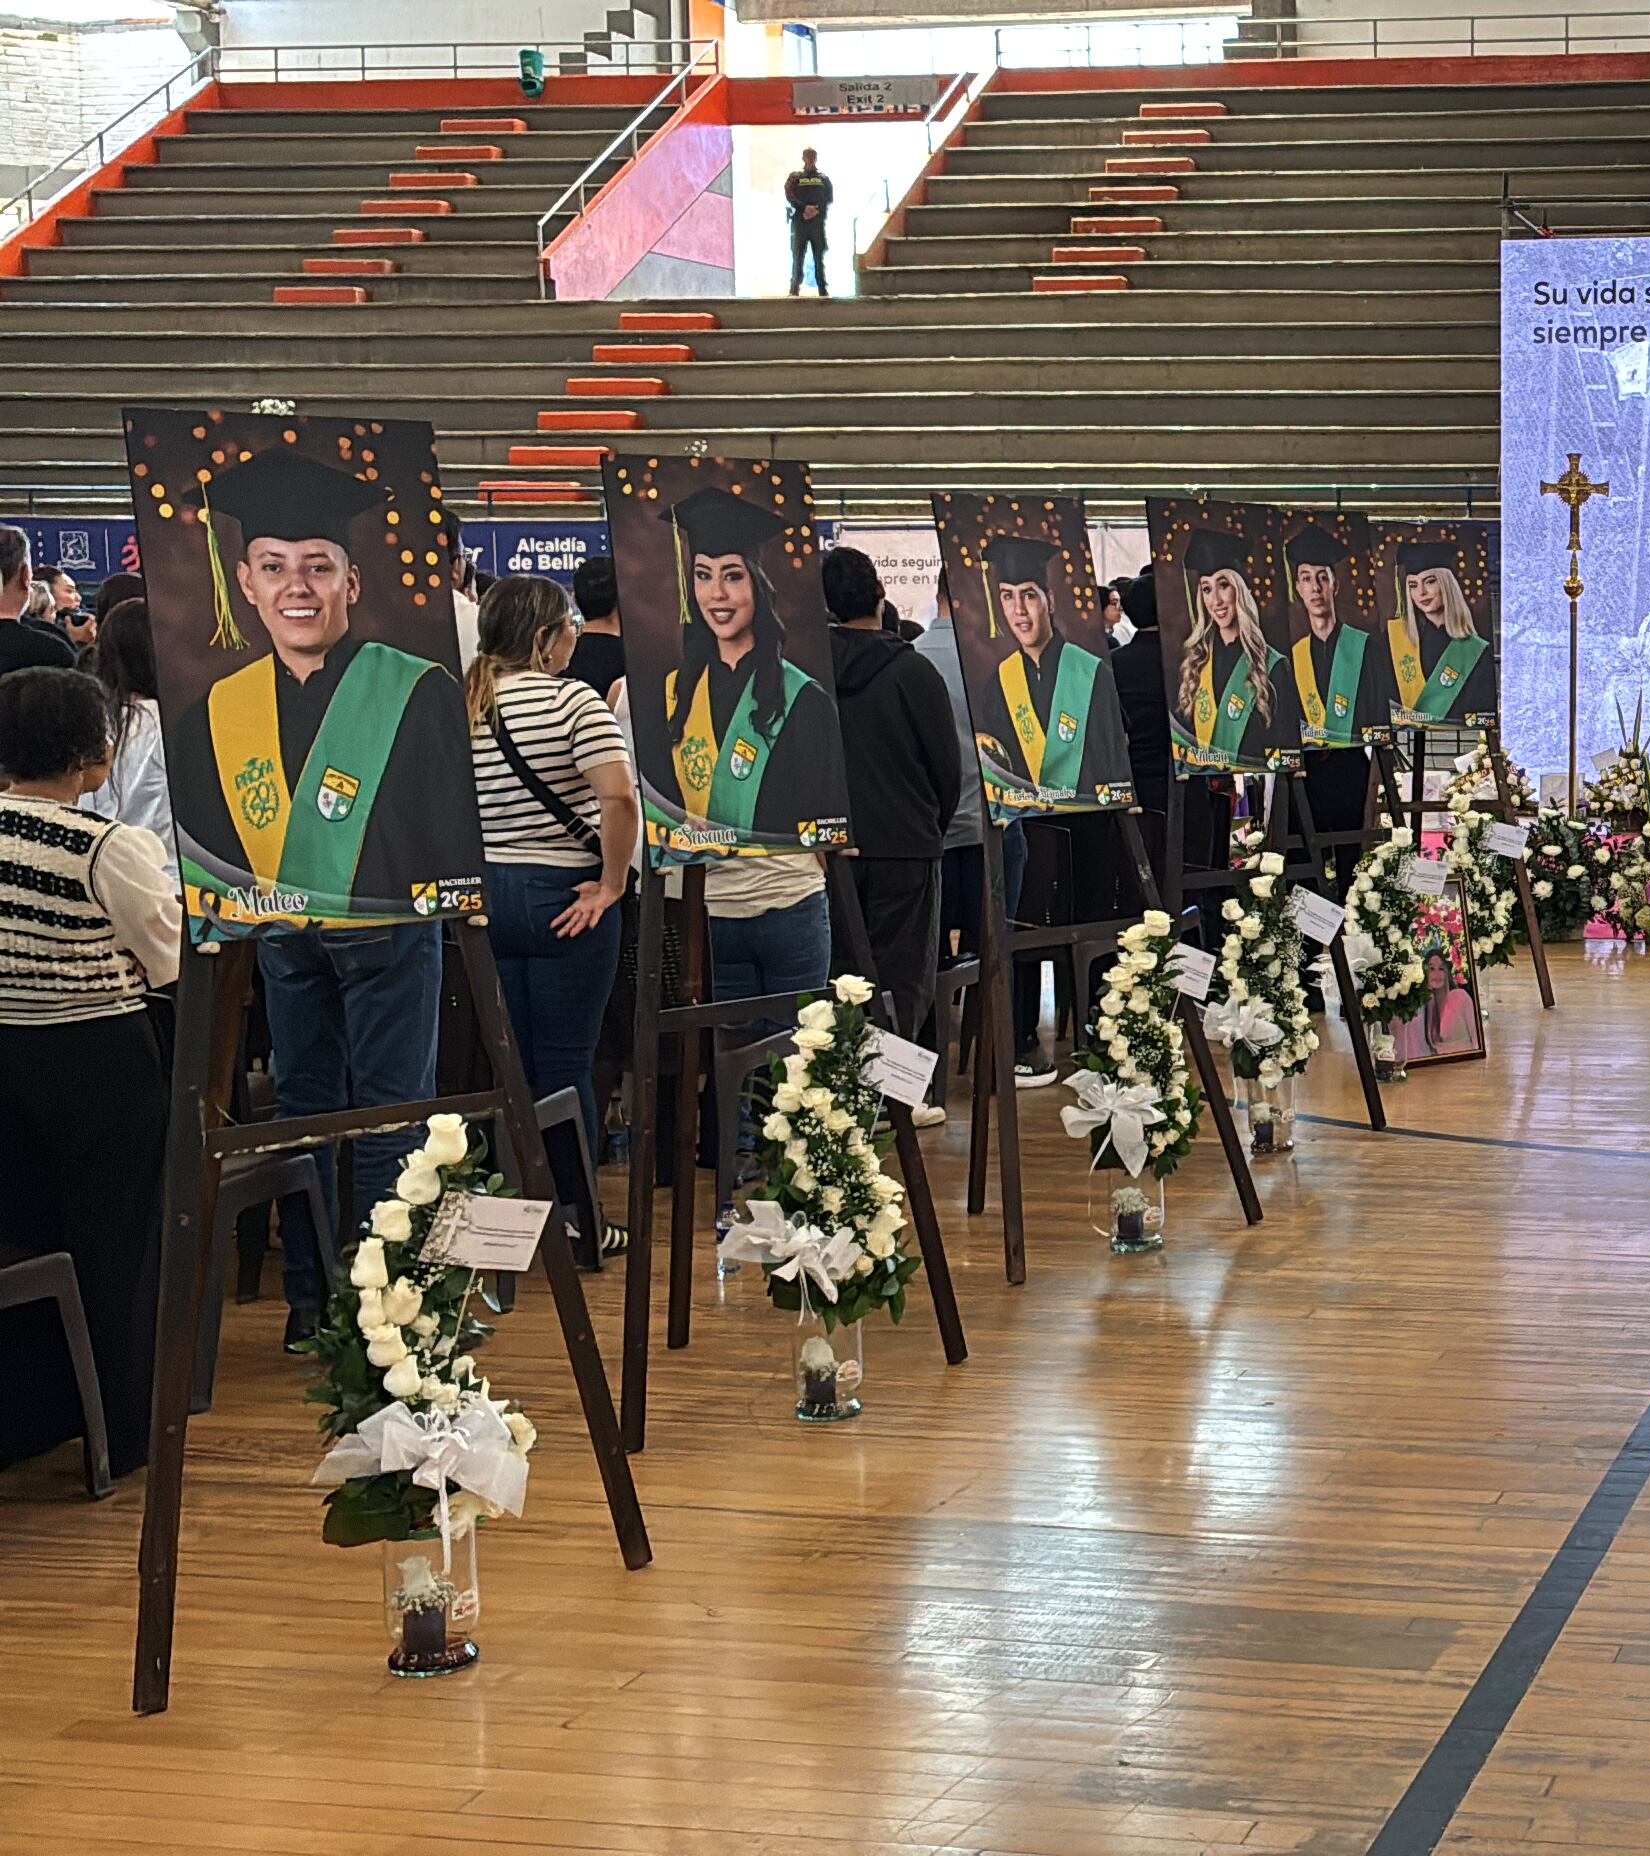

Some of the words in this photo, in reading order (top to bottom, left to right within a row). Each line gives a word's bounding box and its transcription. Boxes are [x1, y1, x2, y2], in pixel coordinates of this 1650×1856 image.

[839, 82, 880, 92] Salida
[884, 82, 893, 91] 2
[847, 95, 873, 104] Exit
[877, 95, 885, 103] 2
[1533, 281, 1571, 307] Su
[1577, 279, 1636, 305] vida
[1533, 321, 1648, 350] siempre
[516, 537, 587, 553] Alcaldía
[508, 553, 533, 570] de
[817, 828, 848, 845] 2025
[228, 886, 309, 919] Mateo
[440, 889, 483, 911] 2025
